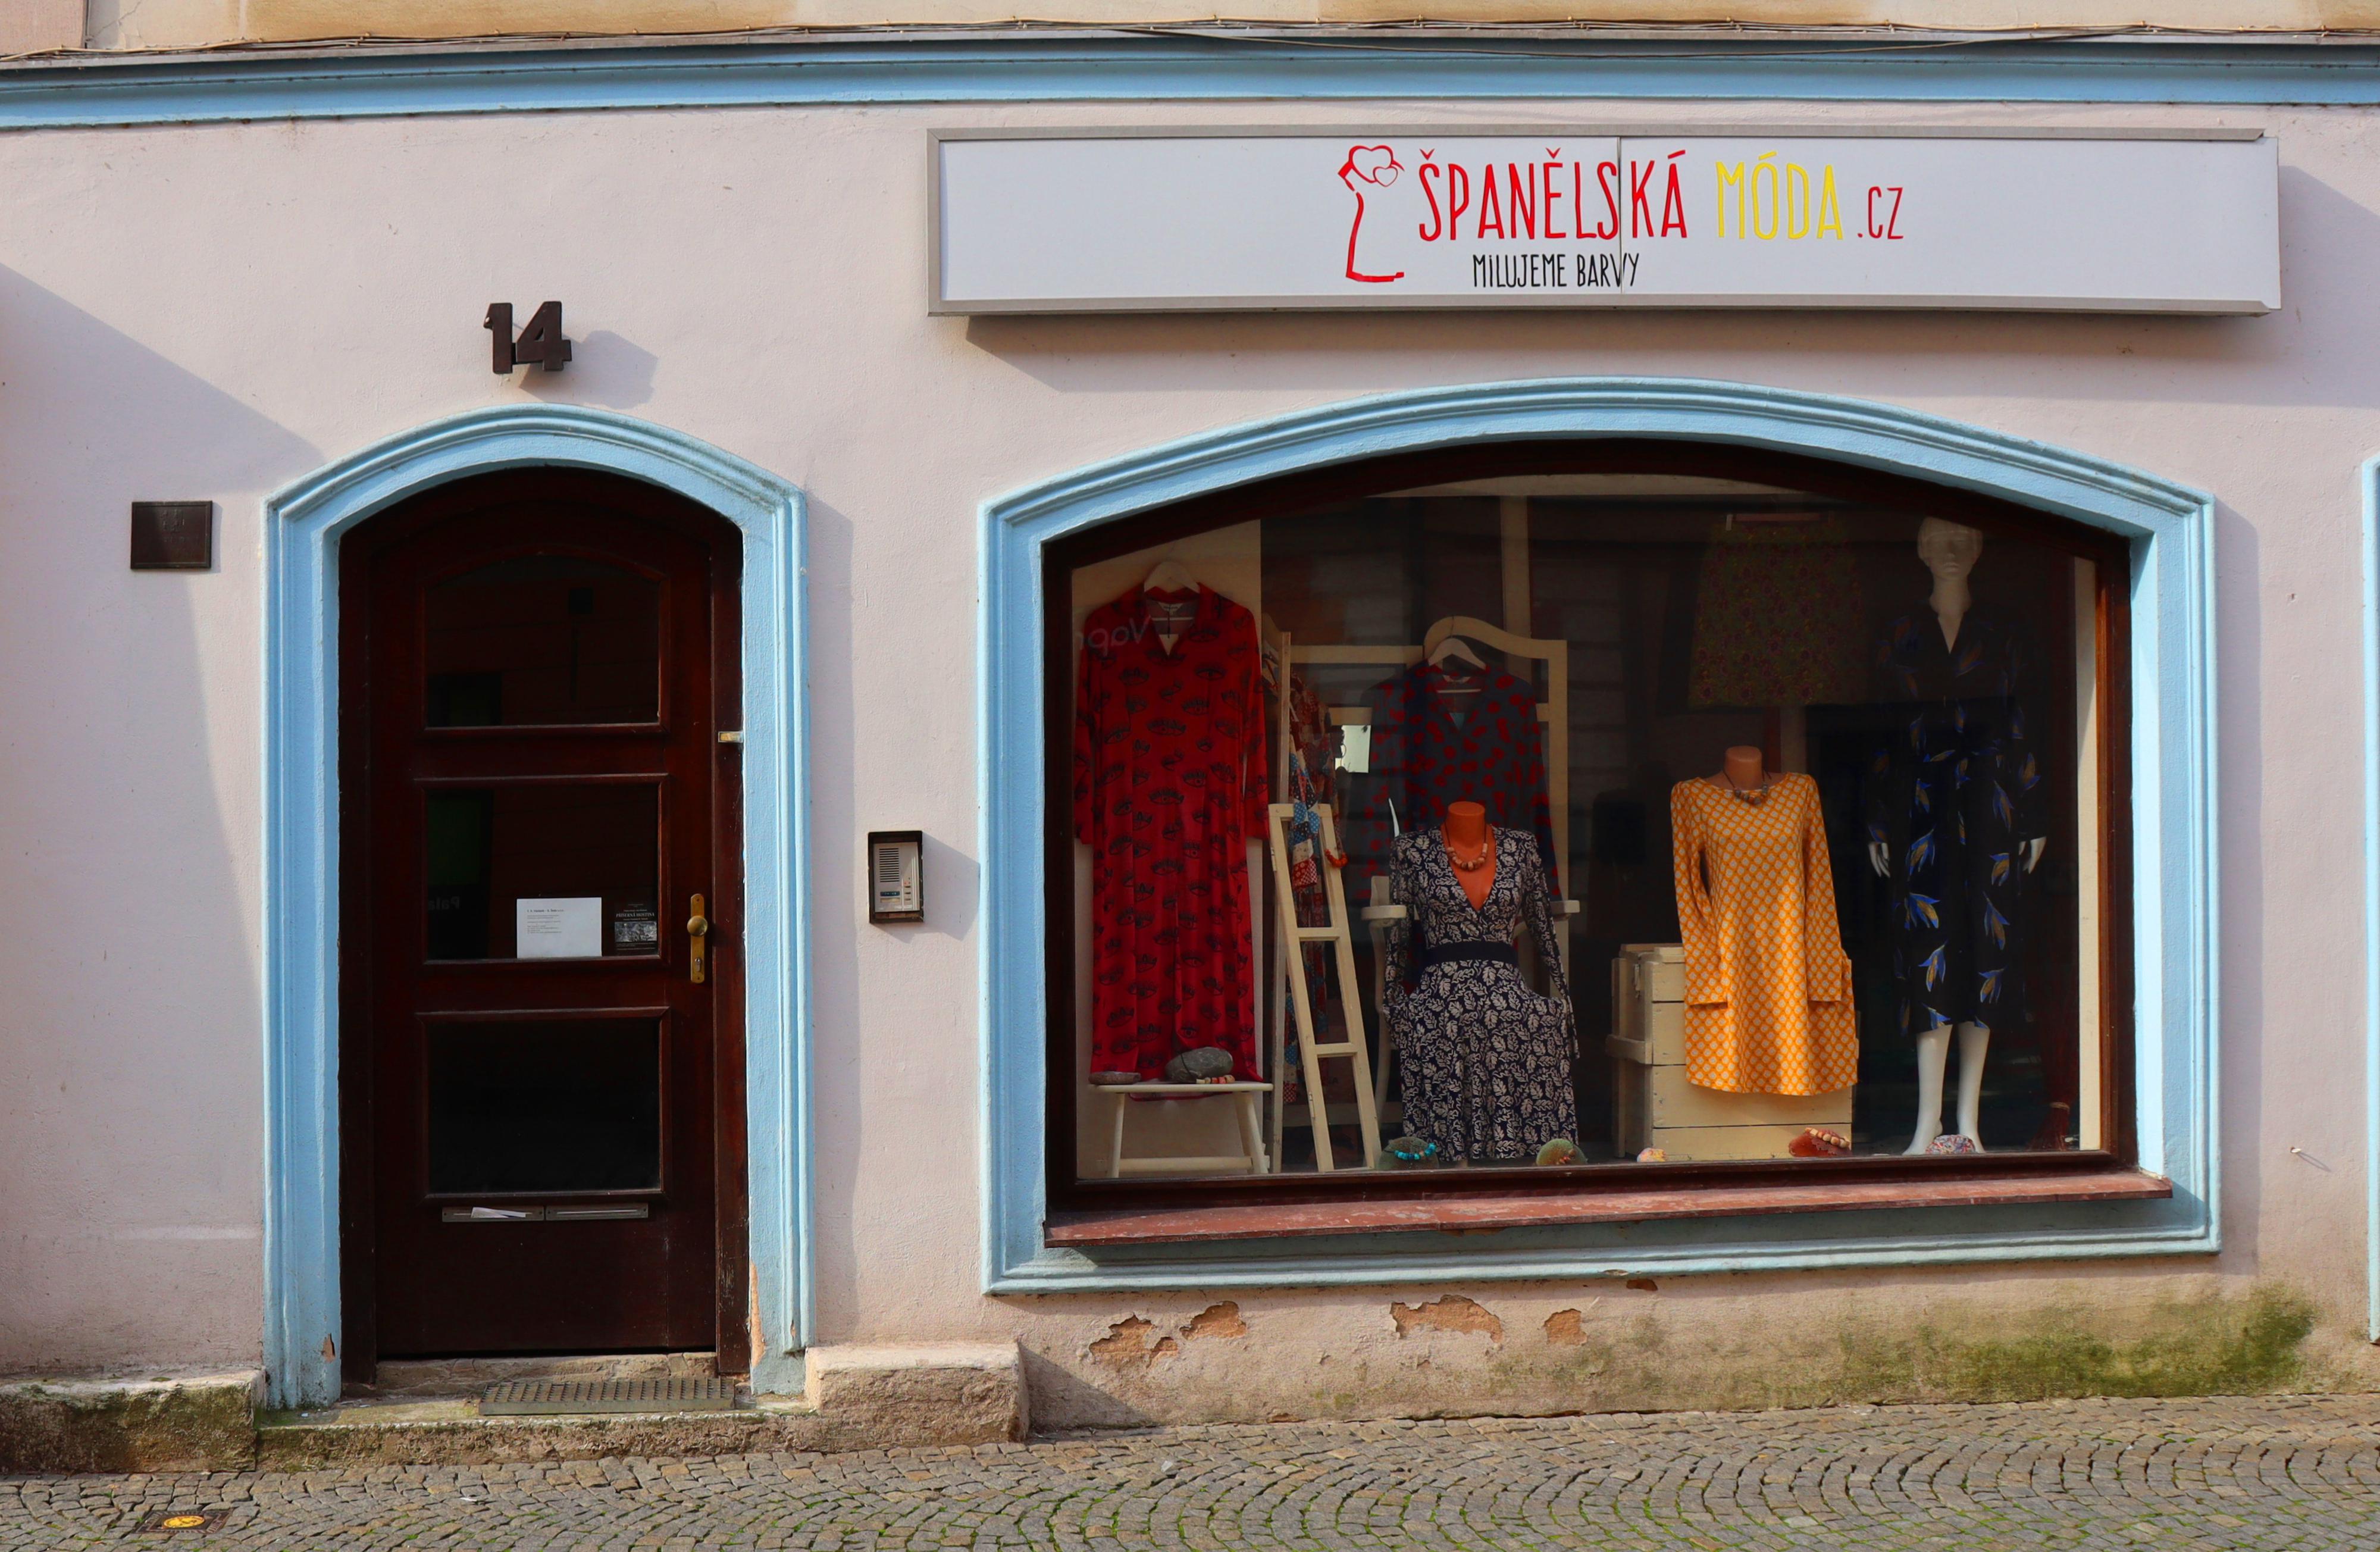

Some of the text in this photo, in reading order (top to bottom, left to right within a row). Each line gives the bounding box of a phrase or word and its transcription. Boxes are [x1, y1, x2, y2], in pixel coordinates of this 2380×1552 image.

[1419, 148, 1687, 242] ŠPANĚLSKÁ
[1715, 151, 1843, 240] MÓDA
[1577, 252, 1639, 287] BARVY
[483, 301, 572, 374] 14
